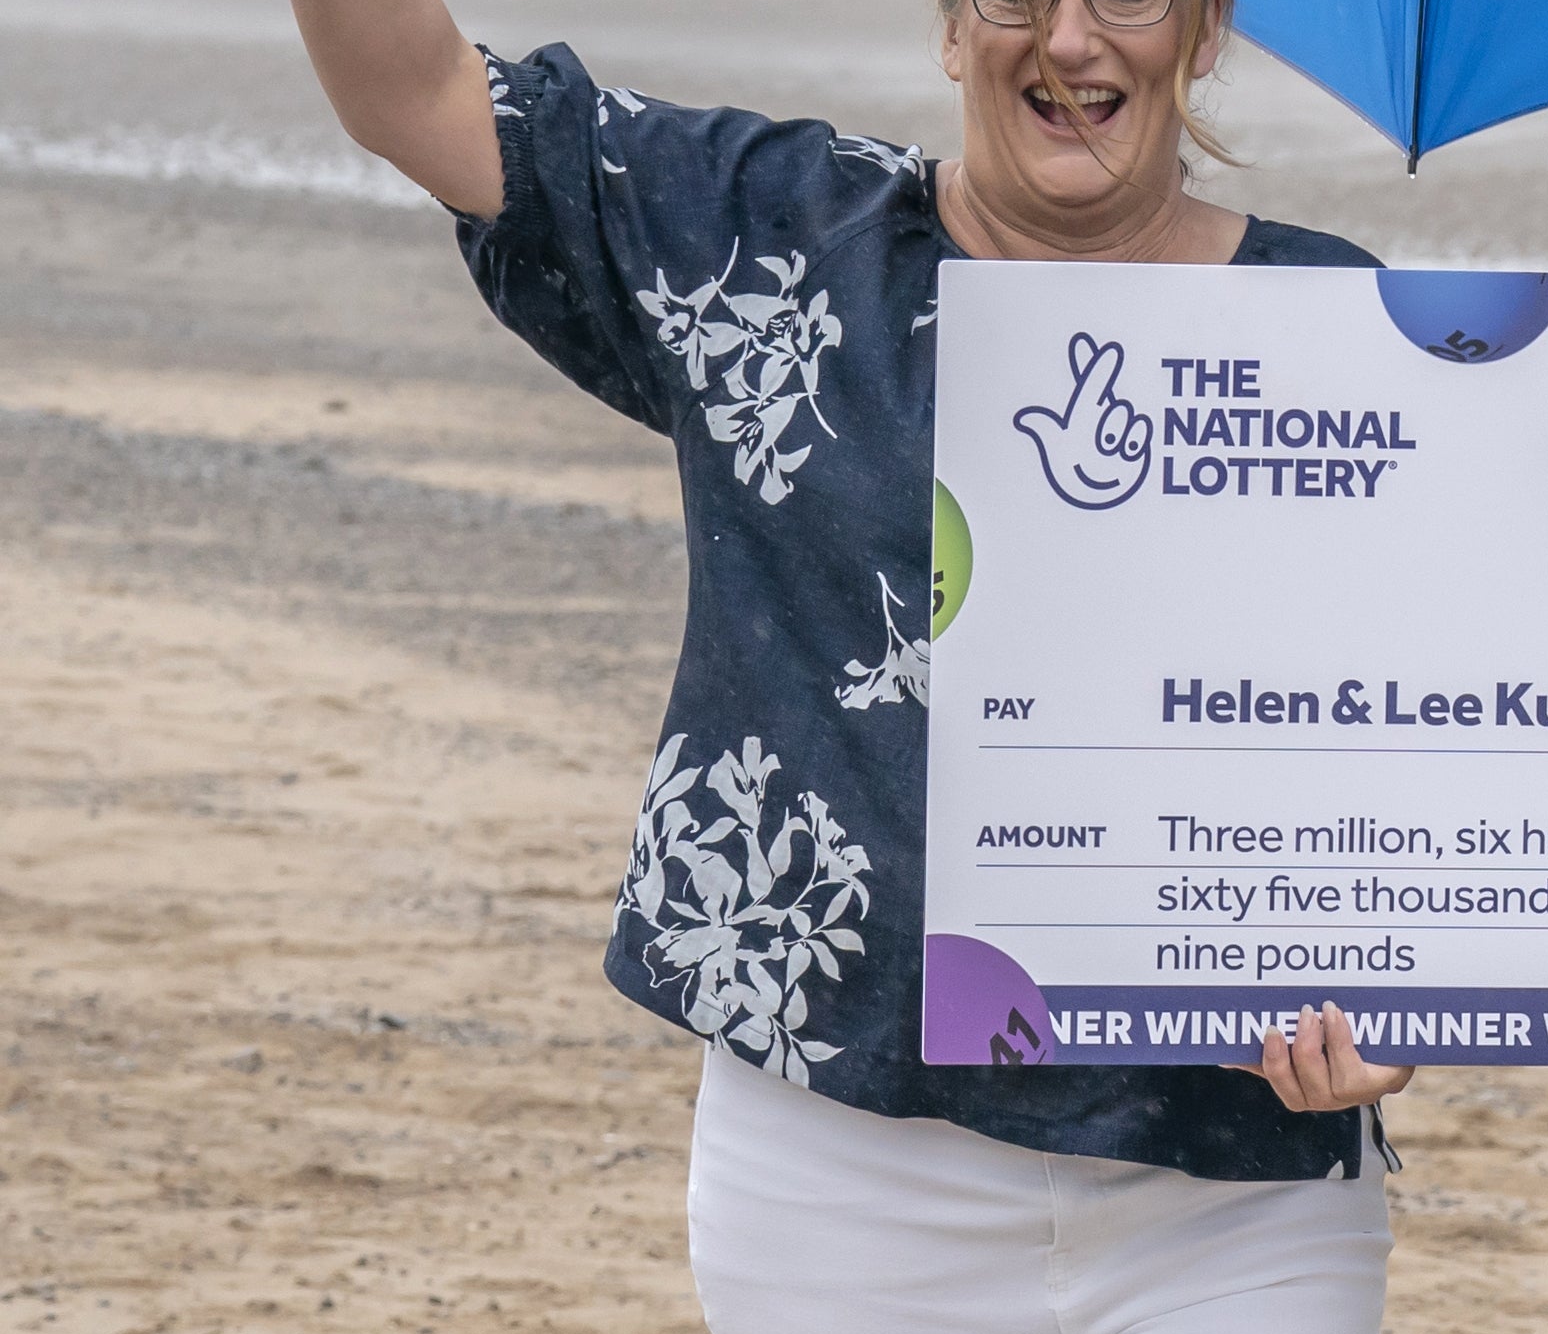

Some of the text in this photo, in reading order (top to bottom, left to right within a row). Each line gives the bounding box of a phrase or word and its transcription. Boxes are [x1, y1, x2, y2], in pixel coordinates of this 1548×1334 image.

[1161, 358, 1261, 398] THE
[1163, 407, 1417, 450] NATIONAL
[983, 697, 1036, 720] PAY
[1162, 678, 1320, 725] Helen
[1331, 679, 1373, 725] &
[1384, 680, 1484, 727] Lee
[975, 825, 1107, 848] AMOUNT
[1157, 815, 1284, 854] Three
[1295, 817, 1443, 860] million,
[1455, 819, 1512, 855] six
[1157, 875, 1254, 922] sixty
[1265, 874, 1342, 913] five
[1156, 934, 1416, 981] nine pounds
[1144, 1010, 1322, 1046] WINNE
[1349, 1011, 1532, 1047] WINNER
